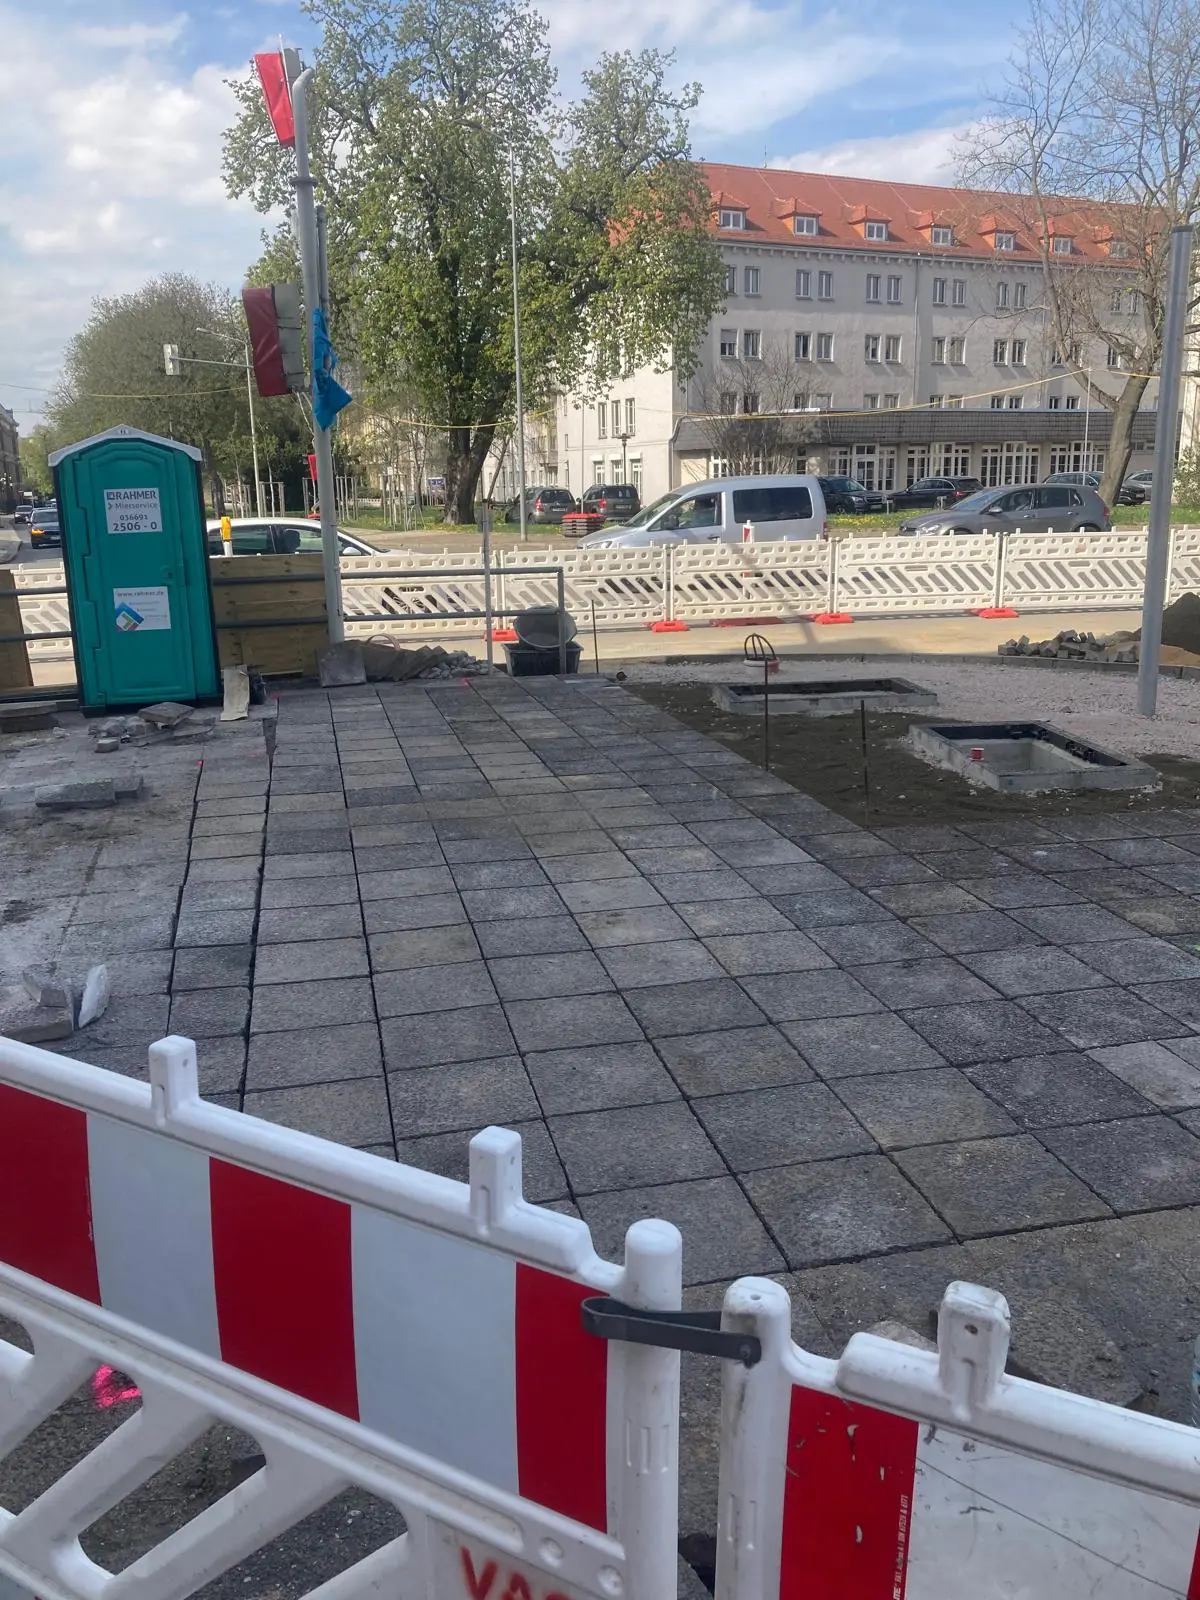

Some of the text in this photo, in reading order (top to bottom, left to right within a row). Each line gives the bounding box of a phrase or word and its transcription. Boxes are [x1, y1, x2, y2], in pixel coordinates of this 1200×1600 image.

[115, 490, 157, 500] RAHMER
[112, 521, 141, 531] 2506
[150, 521, 157, 530] 0
